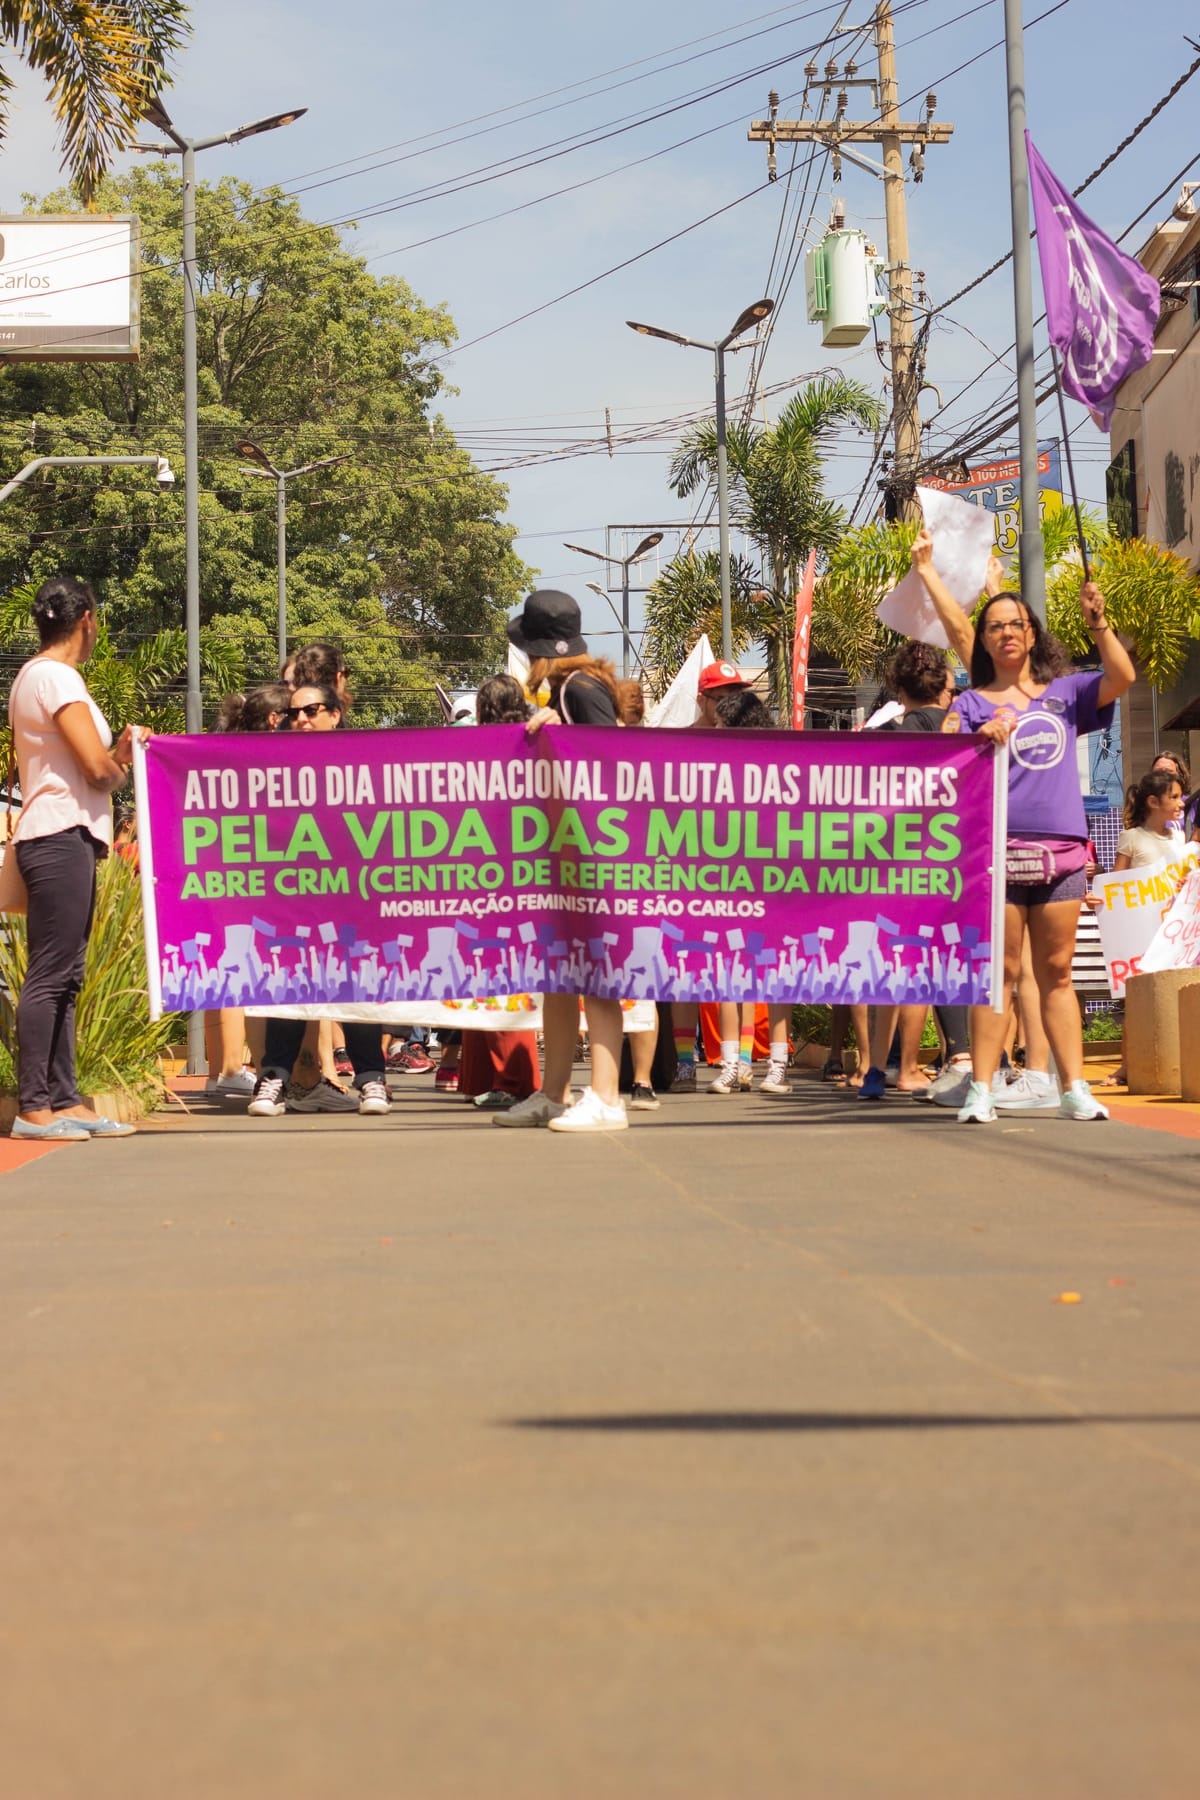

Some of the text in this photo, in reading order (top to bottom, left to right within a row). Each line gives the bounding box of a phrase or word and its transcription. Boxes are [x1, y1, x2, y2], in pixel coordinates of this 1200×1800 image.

[977, 468, 997, 482] 100
[184, 759, 958, 810] ATO PELO DIA INTERNACIONAL DA LUTA DAS MULHERES
[182, 806, 961, 864] PELA VIDA DAS MULHERES
[182, 855, 962, 901] ABRE CRM (CENTRO DE REFERÊNCIA DA MULHER)
[1006, 860, 1045, 871] ONTRA
[380, 894, 765, 919] MOBILIZAÇÃO FEMINISTA DE SÃO CARLOS
